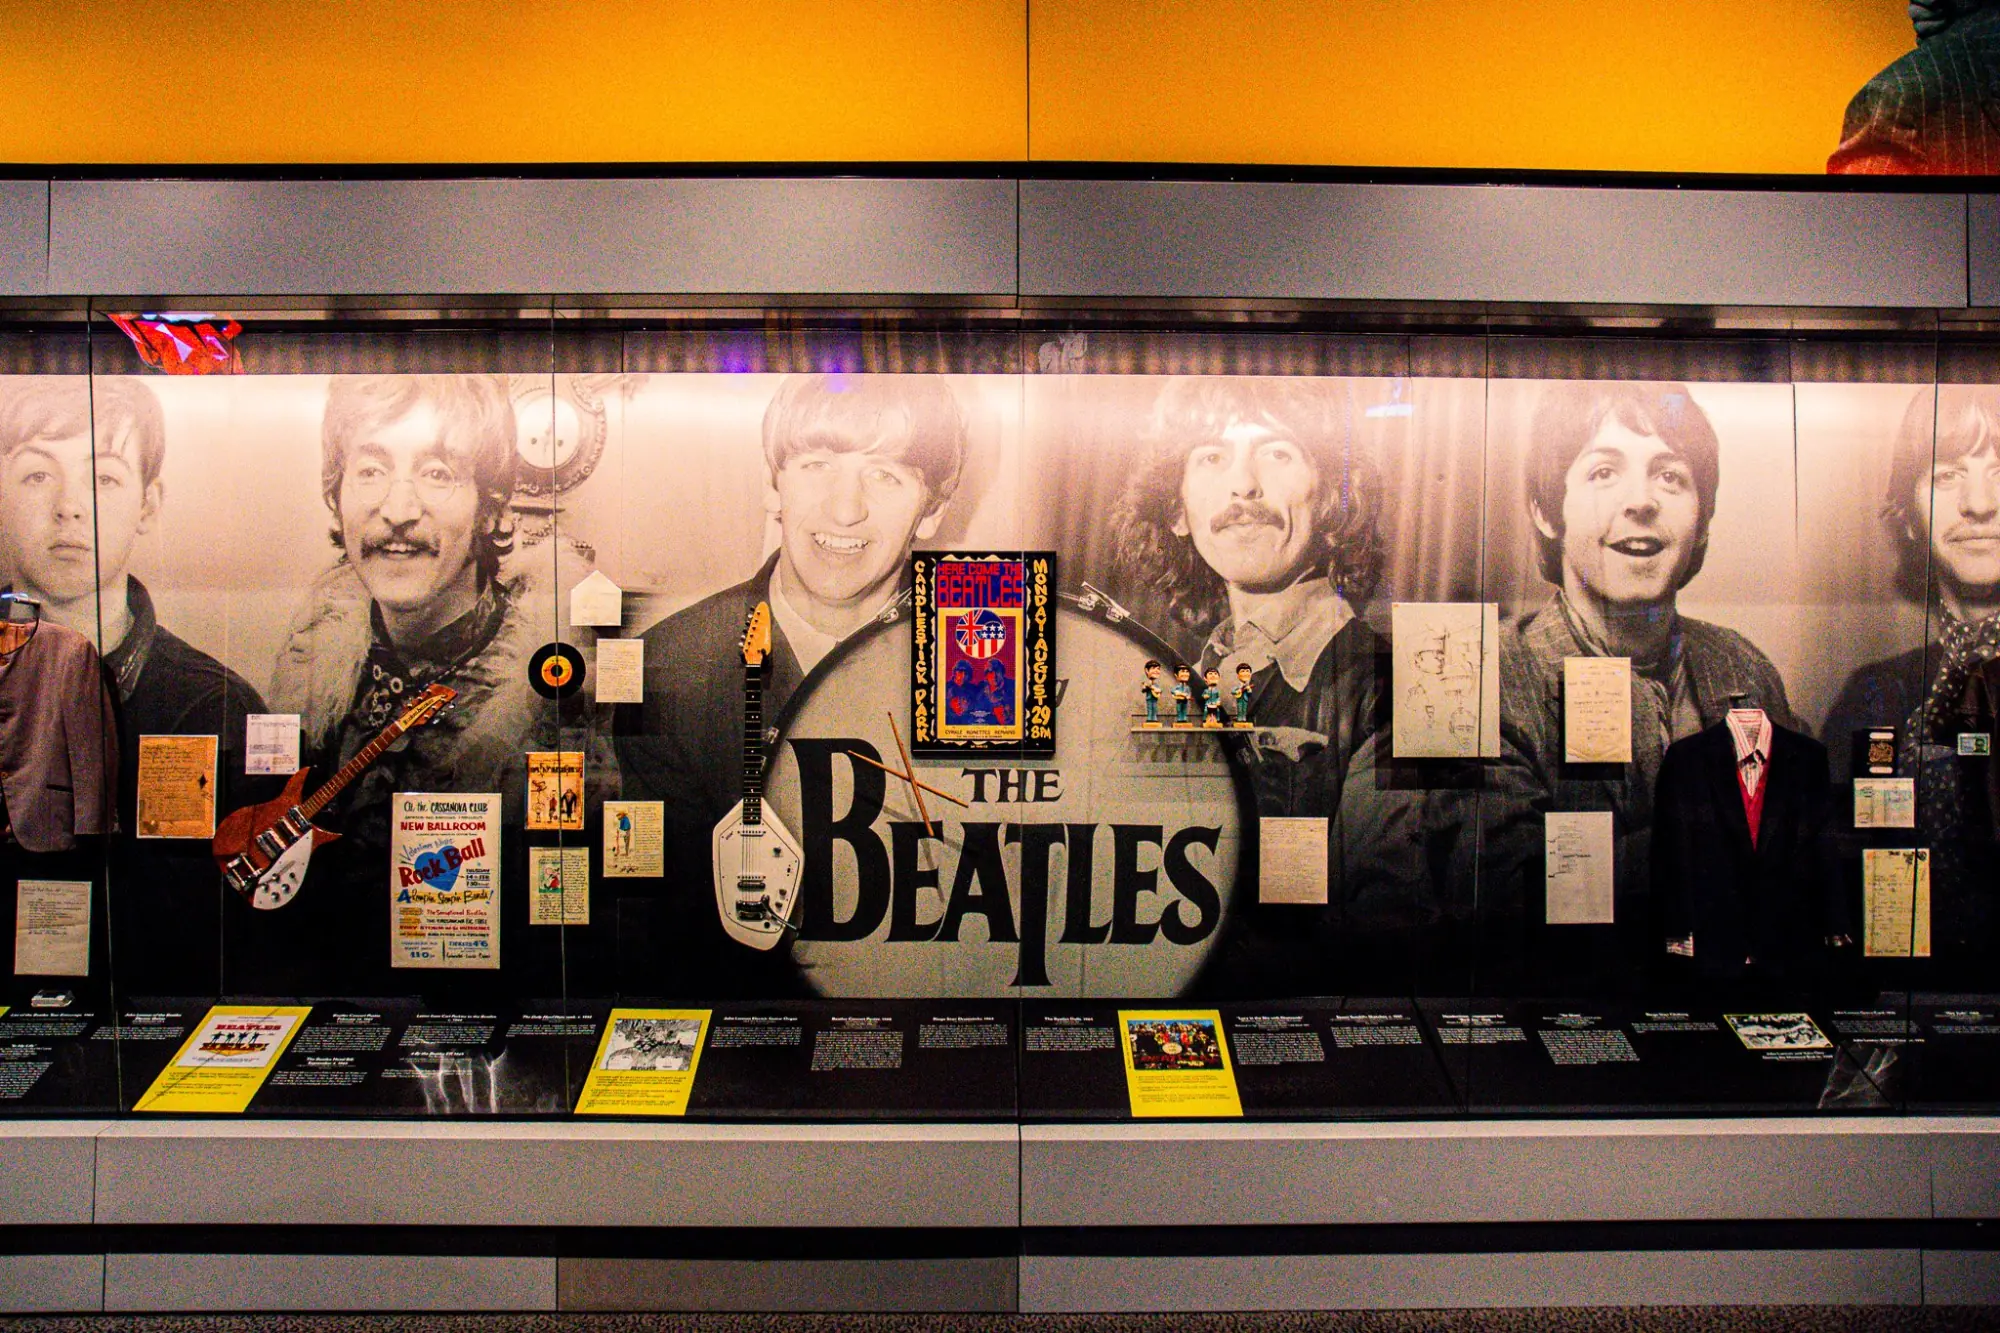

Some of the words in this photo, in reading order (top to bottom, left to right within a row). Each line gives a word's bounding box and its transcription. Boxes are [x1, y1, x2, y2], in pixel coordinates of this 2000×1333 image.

[937, 563, 965, 575] HERE
[968, 563, 1000, 575] COME
[1003, 563, 1023, 575] THE
[937, 575, 1024, 608] BEATLES
[1033, 558, 1048, 632] MONDAY
[914, 560, 929, 685] CANDLESTICK
[1033, 639, 1048, 706] AUGUST
[914, 689, 931, 742] PARK
[1031, 706, 1051, 725] 29
[1031, 726, 1052, 740] 8PM
[962, 768, 1065, 803] THE
[400, 821, 424, 831] NEW
[427, 821, 486, 831] BALLROOM
[398, 858, 447, 888] Rock
[442, 837, 486, 871] Ball
[785, 738, 1224, 988] BEATLES
